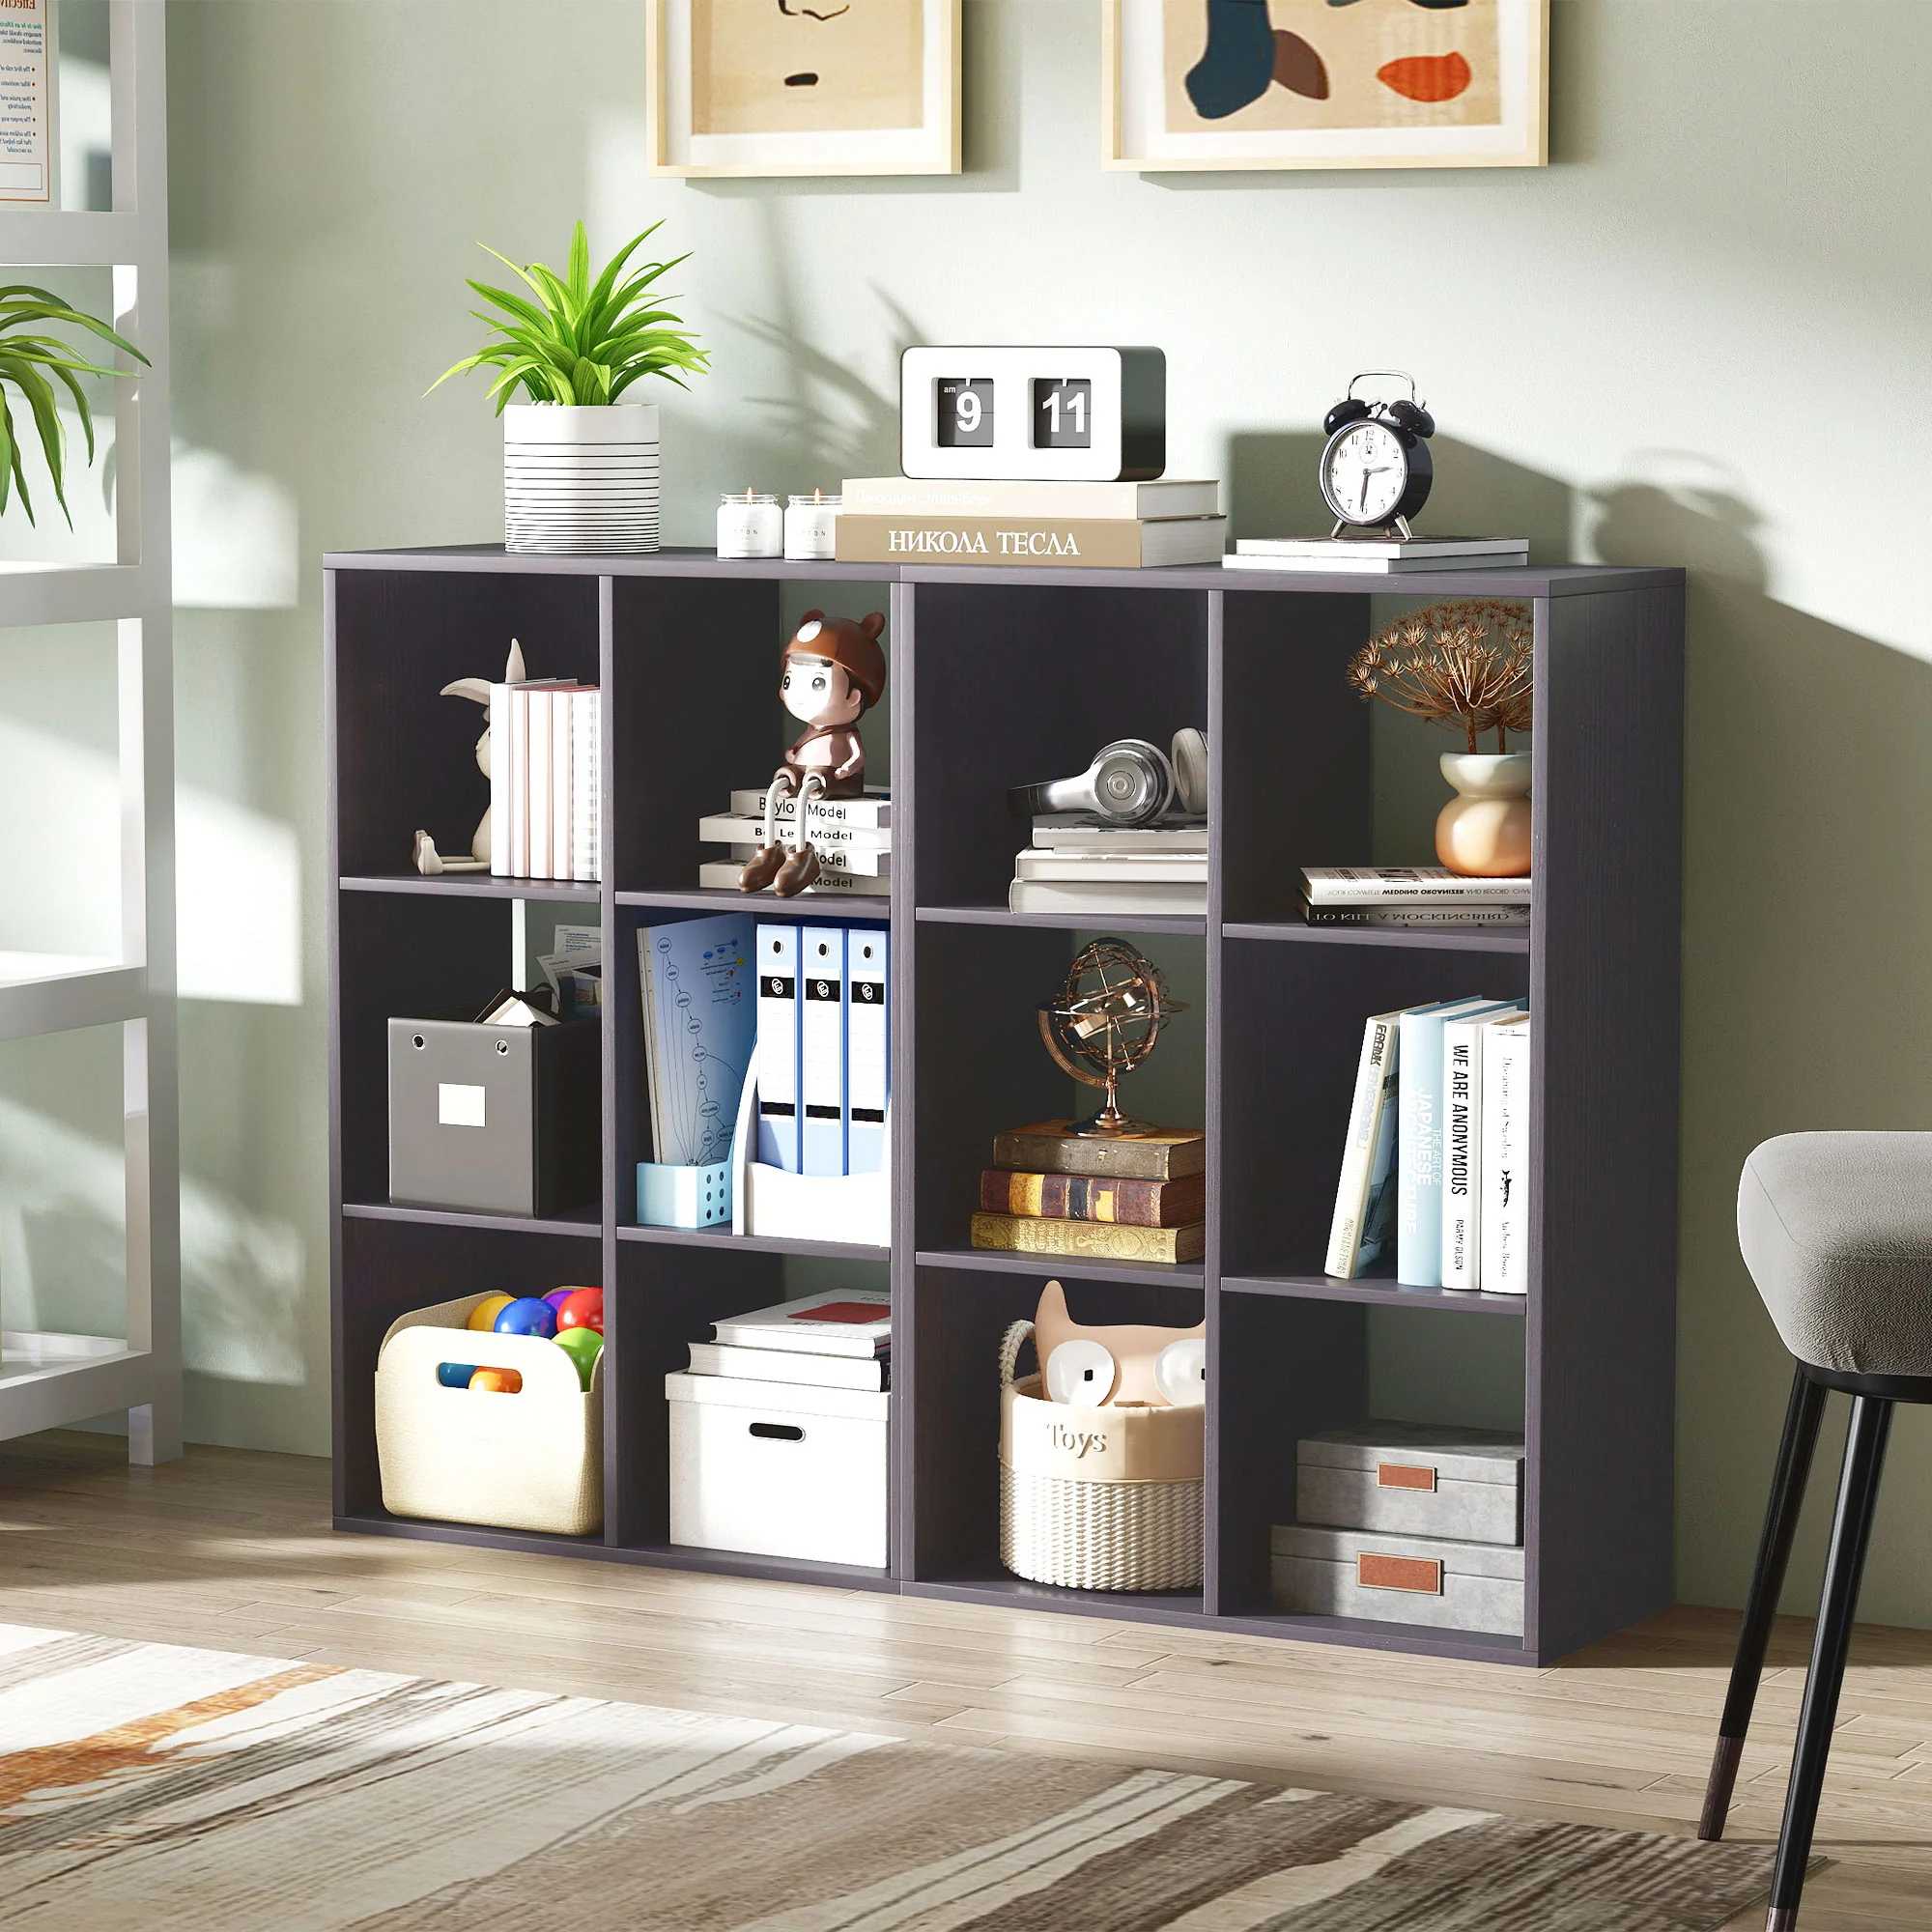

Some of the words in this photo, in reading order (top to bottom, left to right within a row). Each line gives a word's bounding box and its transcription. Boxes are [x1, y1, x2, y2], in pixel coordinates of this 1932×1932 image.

[956, 390, 982, 433] 9
[1041, 390, 1085, 433] 11
[1351, 435, 1359, 445] 11
[1365, 430, 1375, 440] 12
[1382, 435, 1387, 445] 1
[1339, 448, 1348, 459] 10
[1393, 448, 1399, 459] 2
[1331, 468, 1338, 477] 9
[1396, 468, 1403, 478] 3
[1335, 486, 1342, 496] 8
[1347, 498, 1353, 509] 7
[888, 529, 989, 554] НИКОЛА
[996, 531, 1081, 555] ТЕСЛА
[808, 804, 846, 819] Model
[810, 830, 852, 840] Model
[815, 851, 846, 867] odel
[1371, 1024, 1386, 1066] FRANK
[1452, 1044, 1468, 1066] WE
[1452, 1071, 1468, 1099] ARE
[1417, 1088, 1433, 1186] JAPANESE
[1432, 1128, 1442, 1148] THE
[1501, 1121, 1513, 1159] Sweden
[1451, 1103, 1468, 1196] ANONYMOUS
[1432, 1150, 1442, 1168] ART
[1432, 1172, 1442, 1186] OF
[1455, 1219, 1463, 1245] PARMY
[1454, 1246, 1463, 1270] OLSON
[1046, 1423, 1107, 1459] Toys
